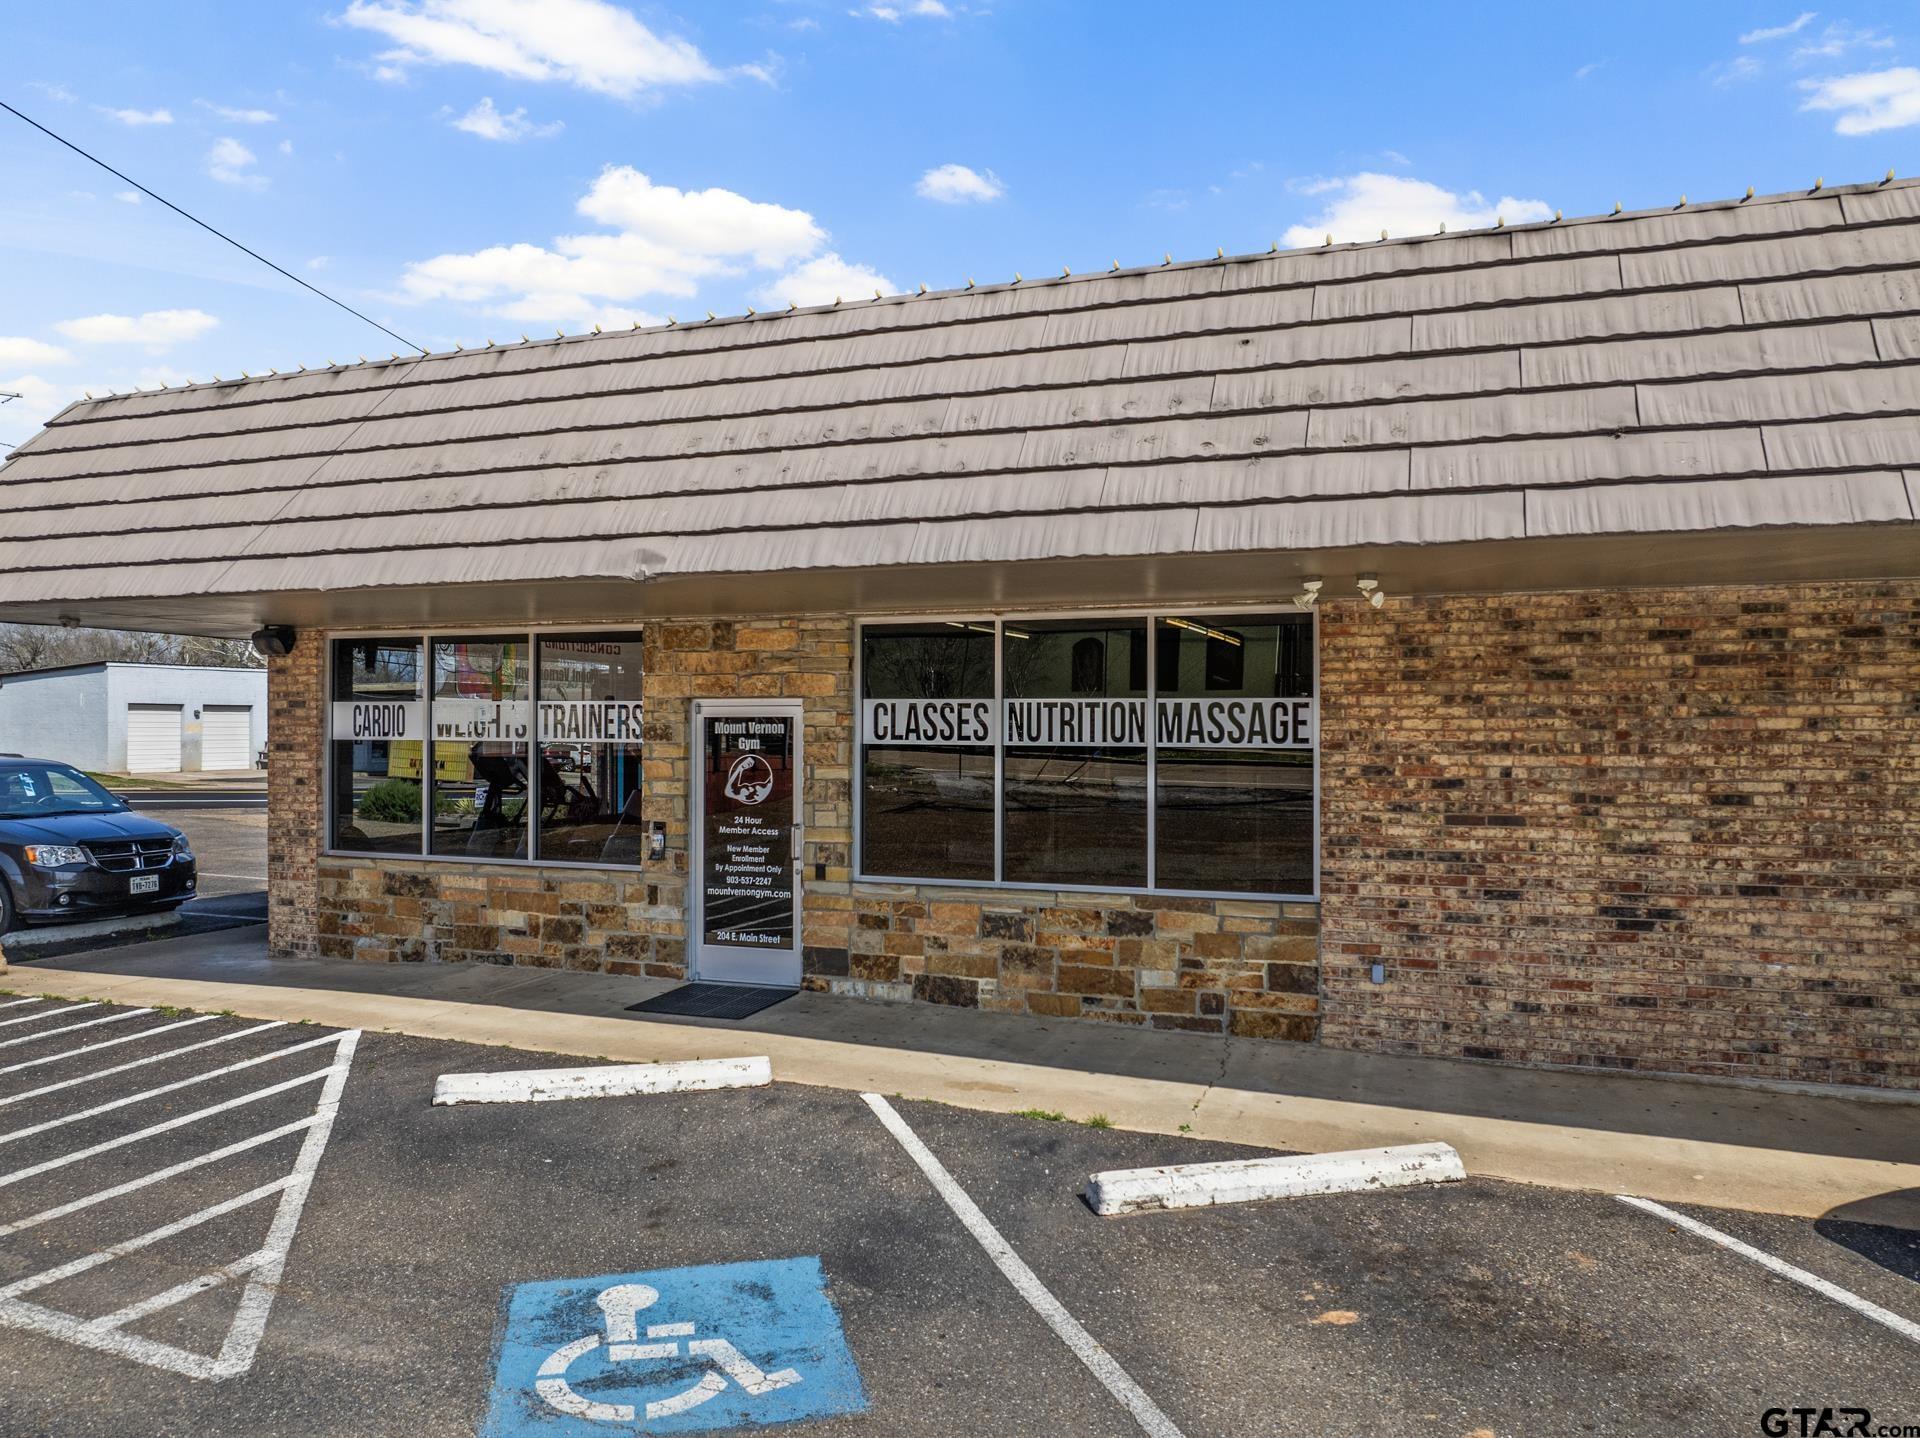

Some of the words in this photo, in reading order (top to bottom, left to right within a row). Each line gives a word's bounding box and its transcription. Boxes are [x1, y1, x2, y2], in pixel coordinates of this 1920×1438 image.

[353, 704, 405, 737] CARDIO
[540, 704, 643, 740] TRAINERS
[873, 702, 989, 742] CLASSES
[1008, 702, 1145, 743] NUTRITION
[1158, 702, 1310, 744] MASSAGE
[714, 722, 746, 735] Mount
[748, 722, 785, 735] Vernon
[738, 737, 760, 751] Gym
[734, 816, 743, 824] 24
[745, 817, 762, 825] Hour
[719, 826, 750, 835] Member
[751, 827, 779, 836] Access
[727, 845, 741, 853] New
[742, 846, 770, 854] Member
[732, 855, 765, 863] Enrollment
[724, 865, 766, 873] Appointment
[766, 866, 782, 875] Only
[726, 876, 772, 885] 903-537-2247
[707, 887, 791, 899] mountvernongym.com
[717, 931, 730, 941] 204
[731, 932, 738, 941] E.
[739, 933, 758, 942] Main
[759, 934, 780, 944] Street
